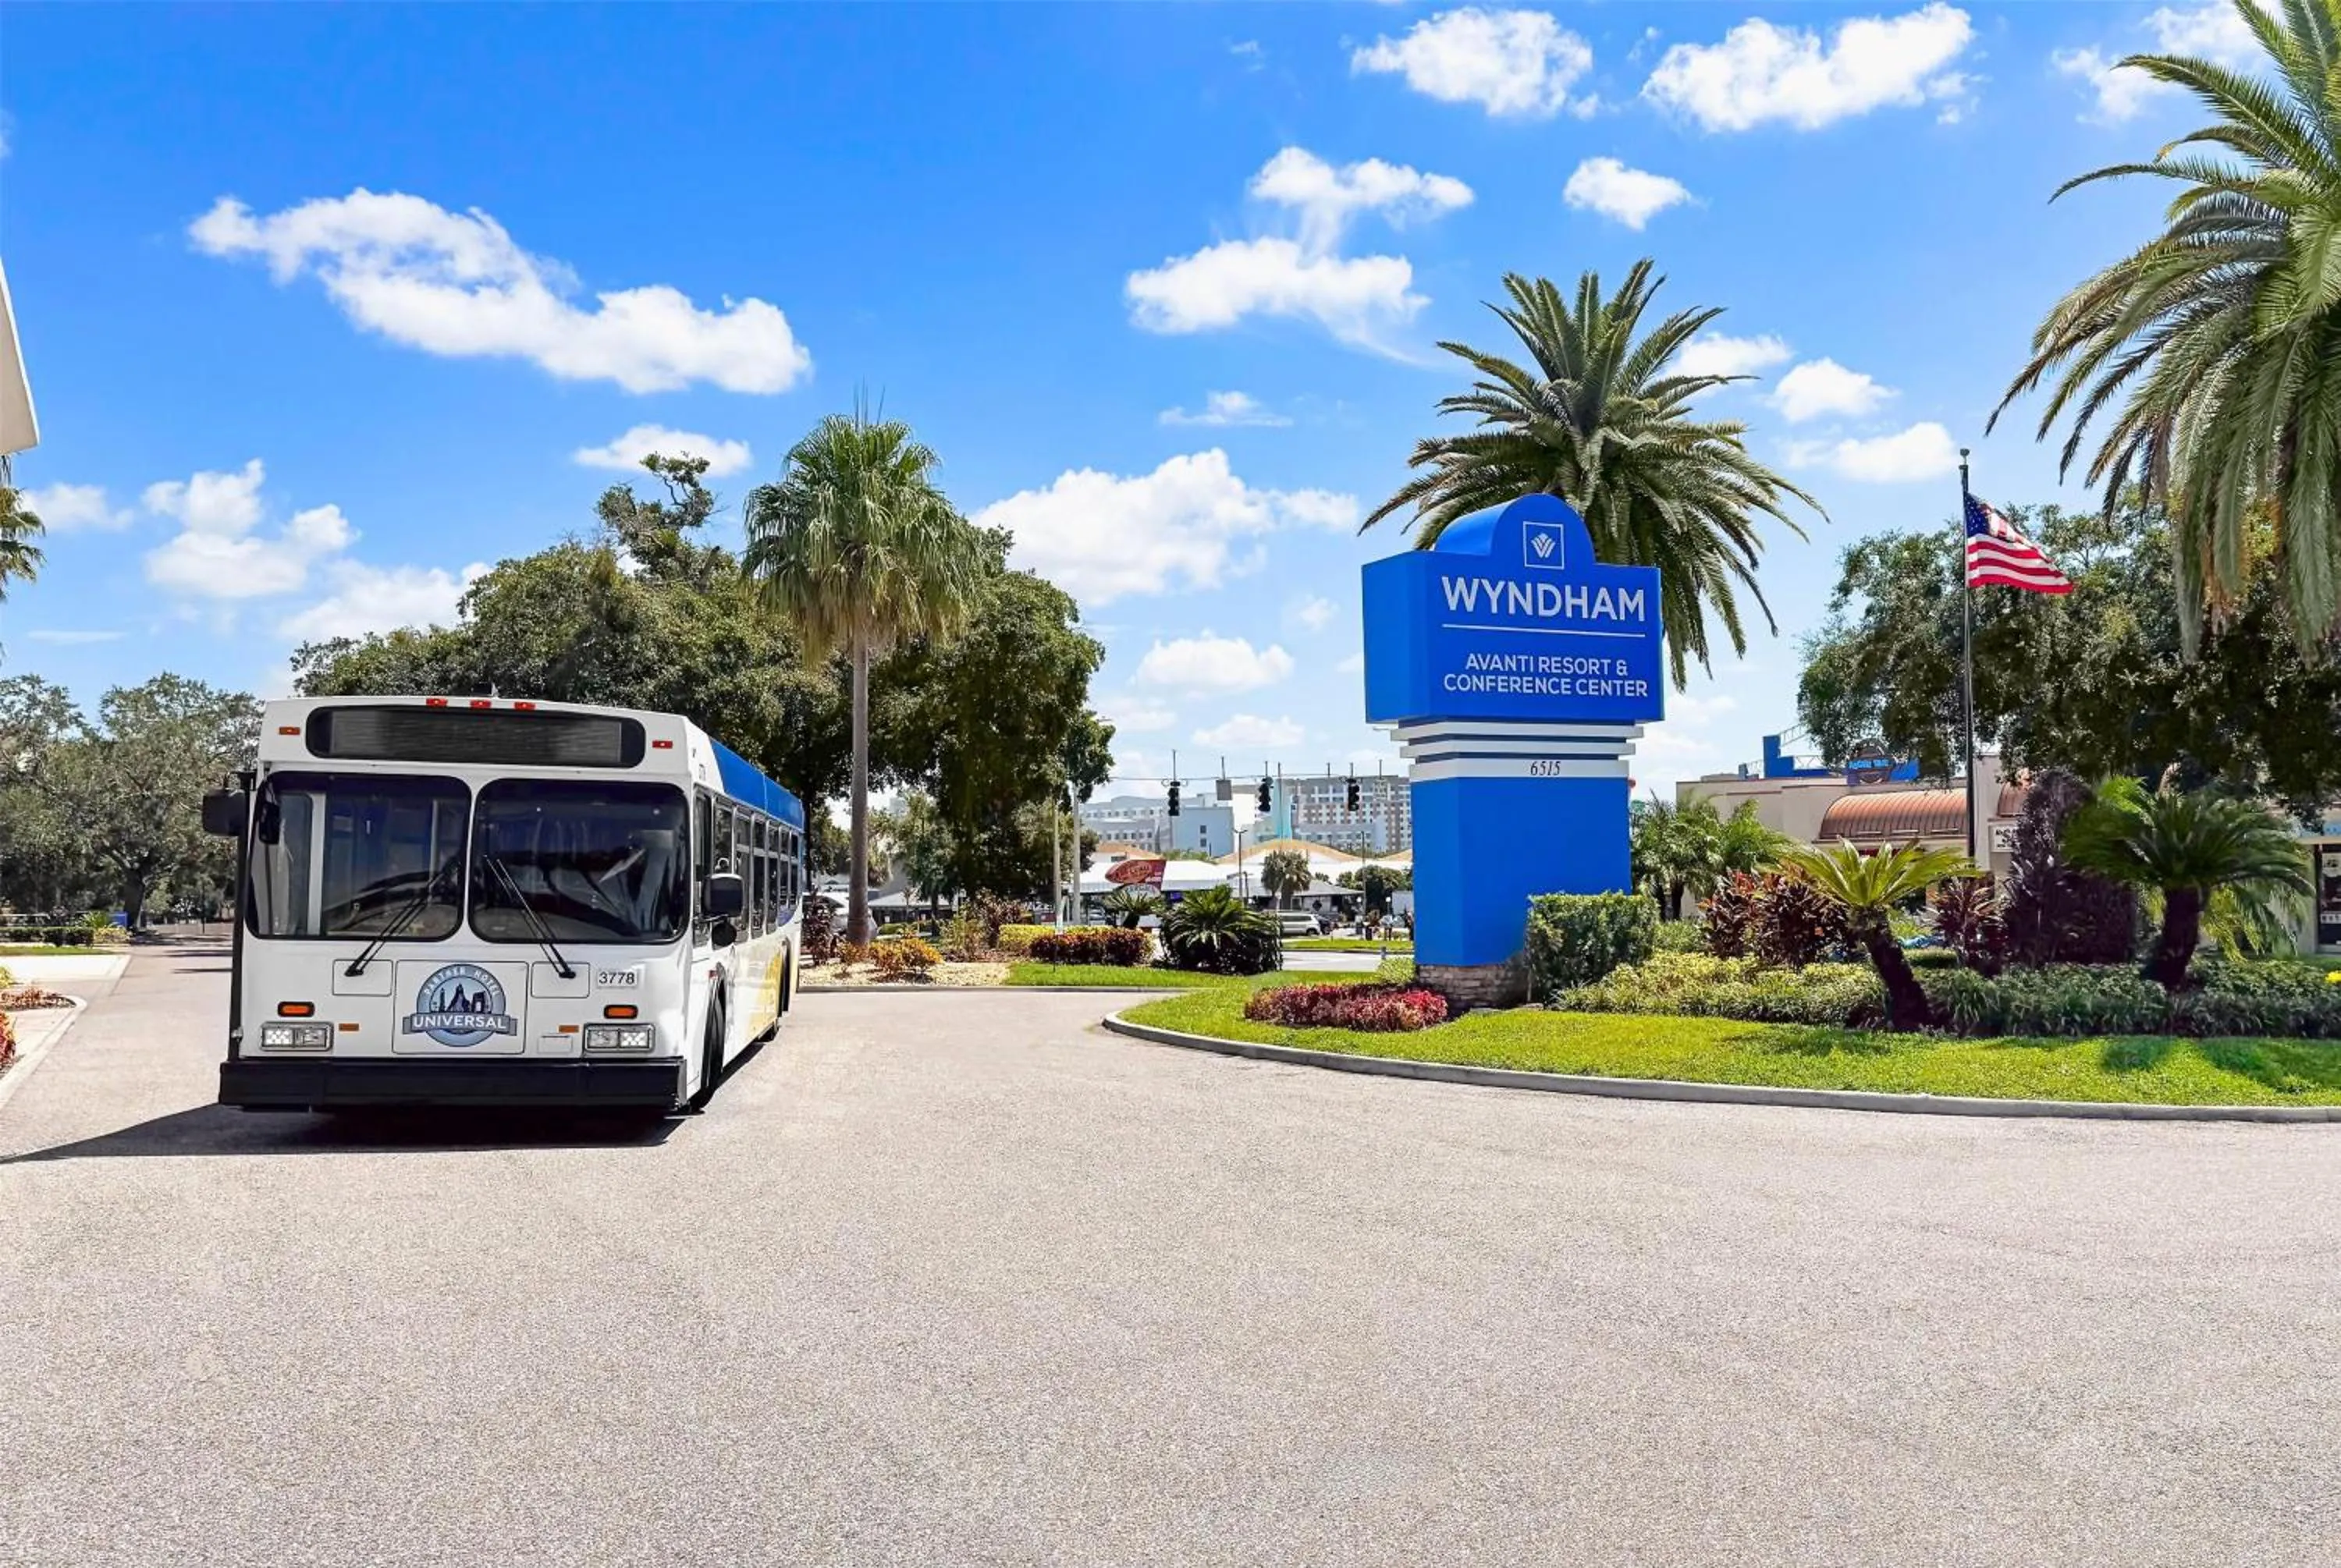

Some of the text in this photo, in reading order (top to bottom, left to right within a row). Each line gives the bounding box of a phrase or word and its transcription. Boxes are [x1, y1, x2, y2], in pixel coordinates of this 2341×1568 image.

[1441, 576, 1646, 622] WYNDHAM
[1465, 653, 1629, 676] AVANTI RESORT &
[1444, 673, 1648, 697] CONFERENCE CENTER
[1530, 761, 1561, 776] 6515
[474, 970, 501, 996] HOTEL
[599, 971, 634, 984] 3778
[413, 1015, 506, 1029] UNIVERSAL
